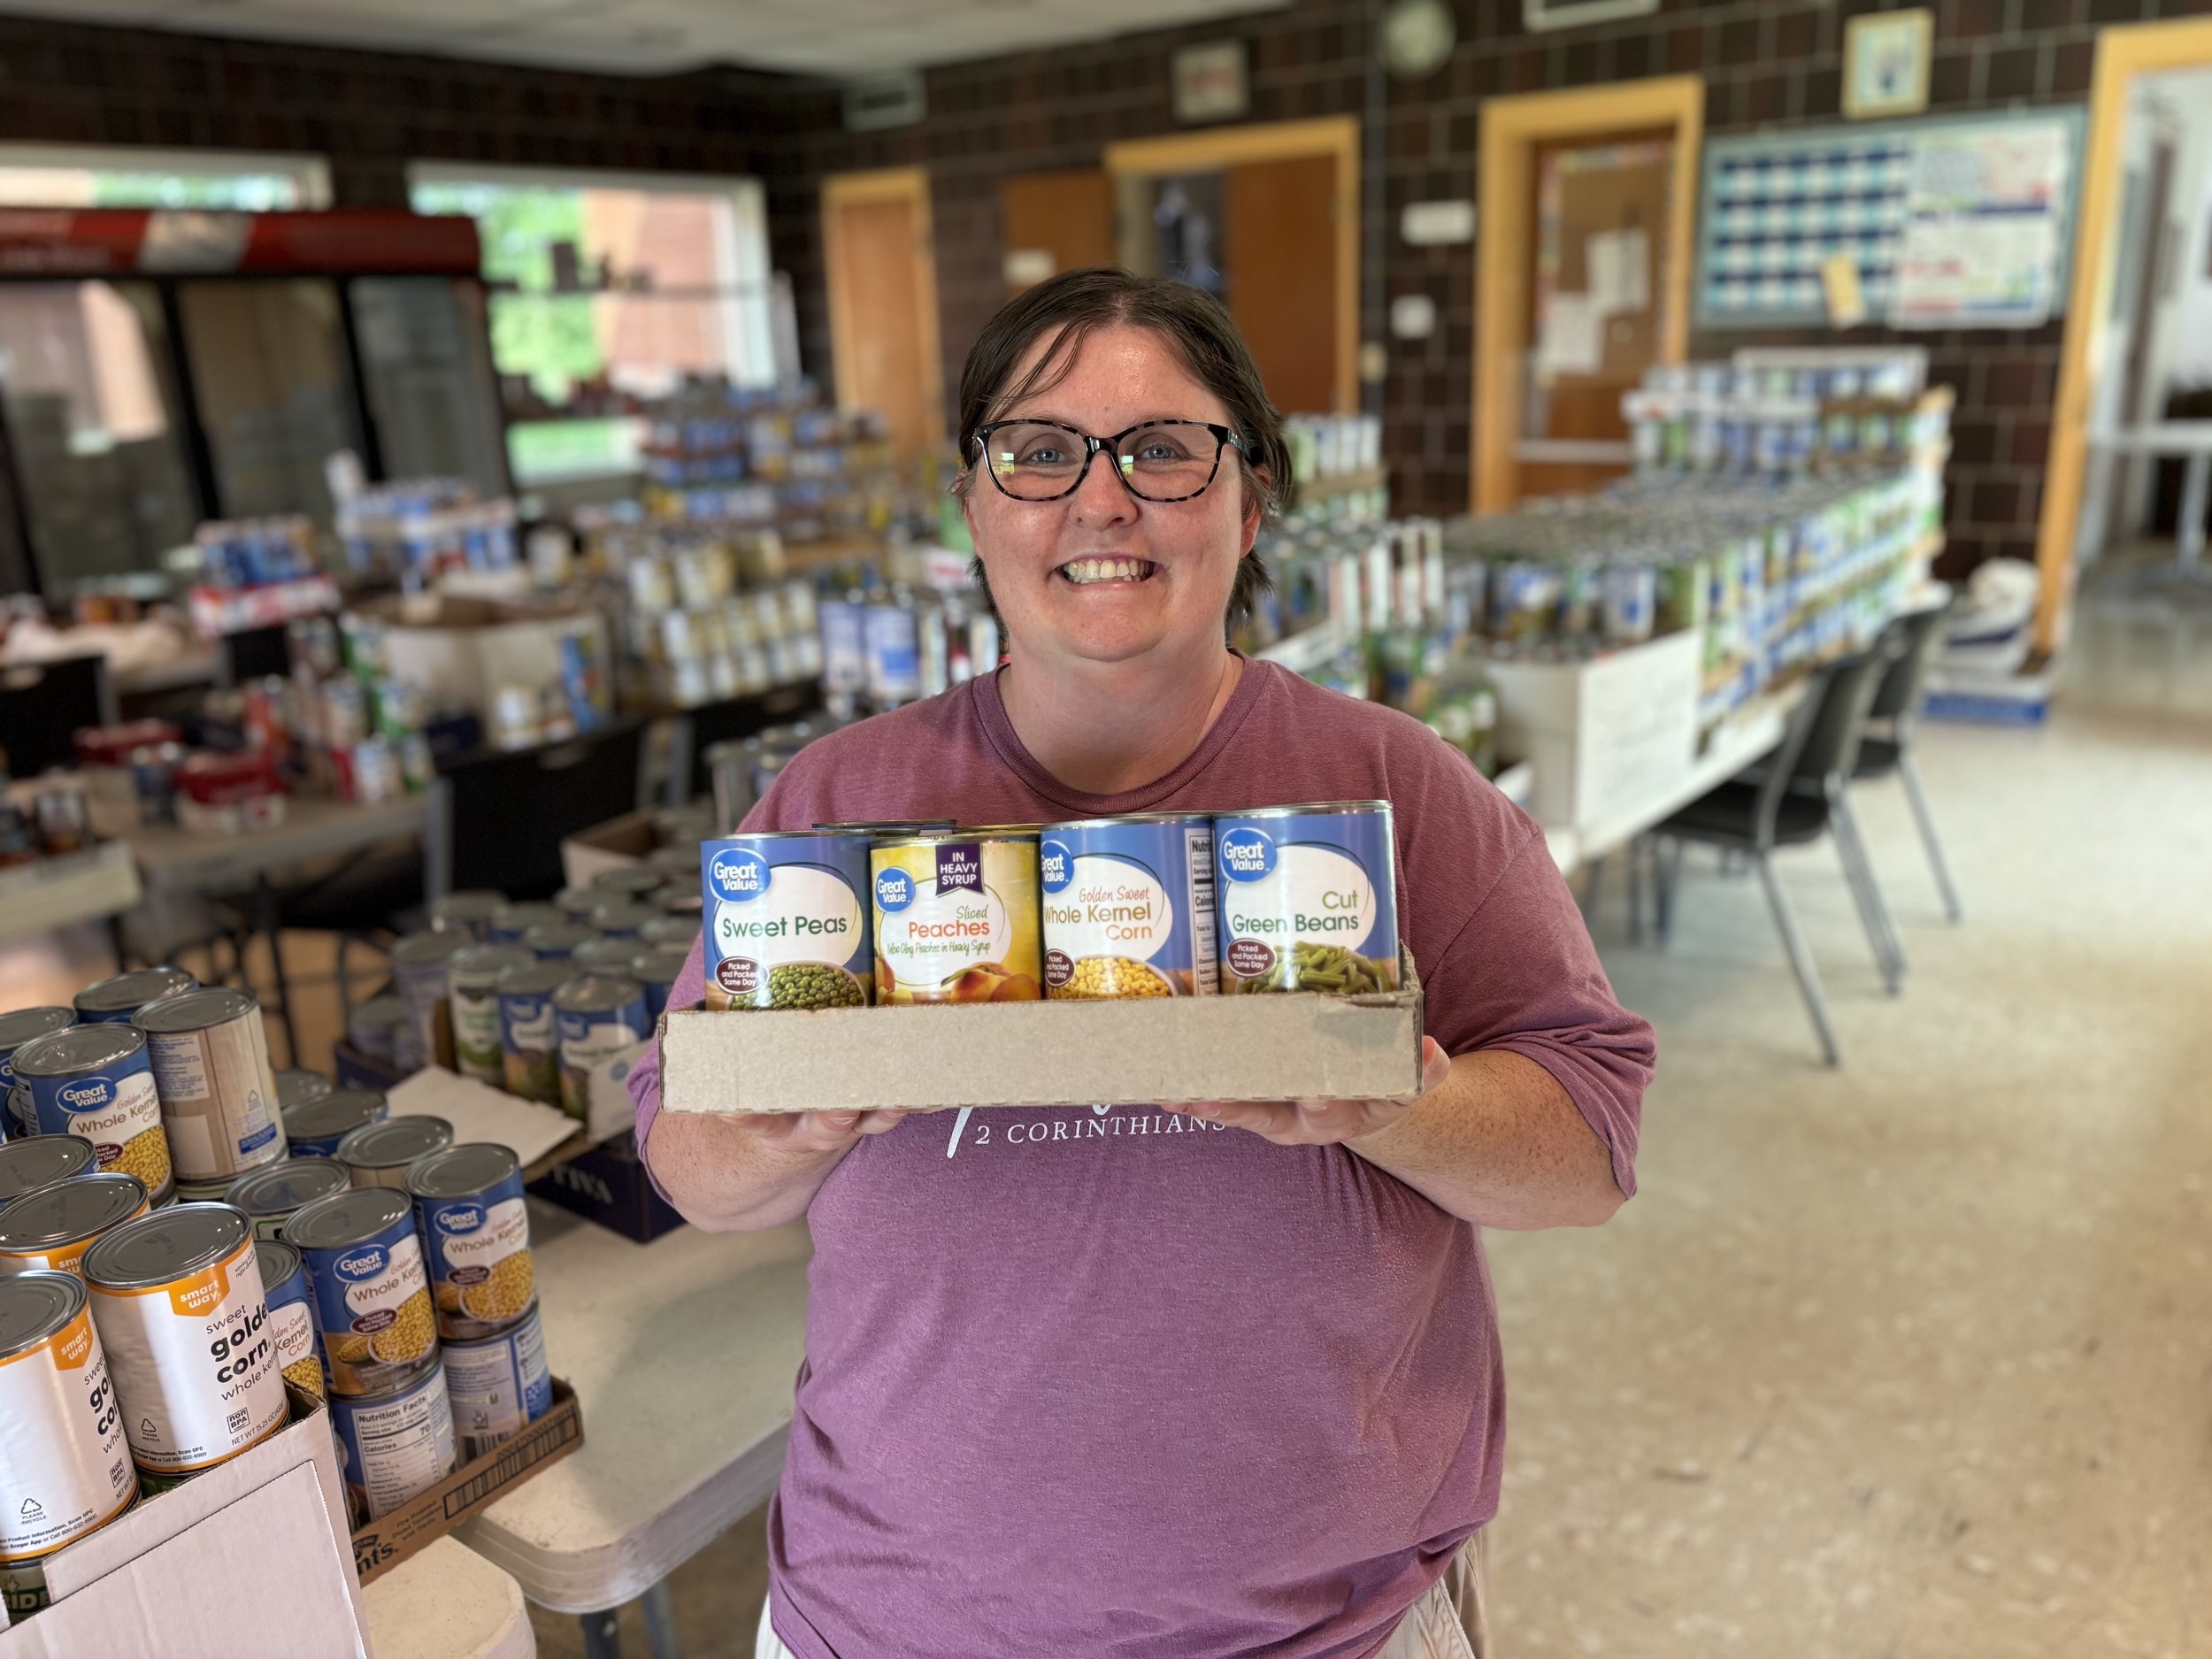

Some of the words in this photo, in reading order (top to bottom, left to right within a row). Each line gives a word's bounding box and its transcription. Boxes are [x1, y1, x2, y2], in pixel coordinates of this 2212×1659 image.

[952, 852, 964, 862] IN
[1225, 841, 1264, 859] Great
[714, 862, 757, 879] Great
[940, 863, 978, 873] HEAVY
[1232, 858, 1264, 871] Value
[722, 879, 758, 891] Value
[878, 878, 906, 894] Great
[942, 874, 977, 885] SYRUP
[883, 892, 907, 902] Value
[1079, 886, 1113, 903] Golden
[1118, 885, 1149, 901] Sweet
[1322, 889, 1358, 910] Cut
[956, 904, 988, 919] Sliced
[1044, 905, 1081, 924] Whole
[1087, 902, 1151, 923] Kernel
[723, 917, 787, 938] Sweet
[795, 916, 847, 935] Peas
[909, 919, 990, 938] Peaches
[1105, 924, 1152, 941] Corn
[1233, 914, 1288, 933] Green
[1294, 914, 1359, 932] Beans
[941, 942, 948, 951] in
[949, 941, 970, 956] Heavy
[972, 940, 991, 954] Syrup
[1250, 960, 1264, 970] Day
[1057, 971, 1067, 979] Day
[63, 1083, 107, 1102] Great
[75, 1094, 108, 1107] Value
[117, 1093, 142, 1110] Golden
[76, 1113, 127, 1133] Whole
[975, 1125, 991, 1144] 2
[440, 1210, 478, 1225] Great
[449, 1236, 495, 1254] Whole
[58, 1256, 82, 1269] sma
[341, 1251, 381, 1271] Great
[352, 1262, 383, 1276] Value
[354, 1278, 399, 1302] Whole
[402, 1260, 421, 1282] Kern
[180, 1279, 219, 1303] smart
[188, 1291, 219, 1310] way
[206, 1304, 247, 1334] sweet
[60, 1327, 88, 1356] smart
[211, 1302, 267, 1363] golde
[275, 1318, 309, 1351] Kernel
[68, 1340, 88, 1361] way
[288, 1333, 311, 1356] Corn
[84, 1352, 105, 1386] sweet
[221, 1371, 262, 1401] whole
[263, 1348, 279, 1374] kern
[90, 1364, 111, 1413] gol
[97, 1398, 118, 1435] cor
[229, 1409, 247, 1422] non
[358, 1409, 401, 1423] Nutrition
[403, 1396, 426, 1412] Facts
[230, 1417, 247, 1428] BPA
[231, 1434, 244, 1446] NET
[245, 1428, 255, 1438] WT
[256, 1418, 268, 1432] 15.25
[268, 1412, 275, 1422] OZ
[364, 1442, 396, 1453] Calories
[419, 1424, 431, 1435] 70
[111, 1462, 122, 1475] non
[112, 1469, 124, 1482] BPA
[22, 1510, 43, 1519] PLEASE
[32, 1524, 67, 1538] Information,
[68, 1515, 82, 1525] Scan
[82, 1508, 94, 1517] UPC
[357, 1542, 394, 1576] nt's
